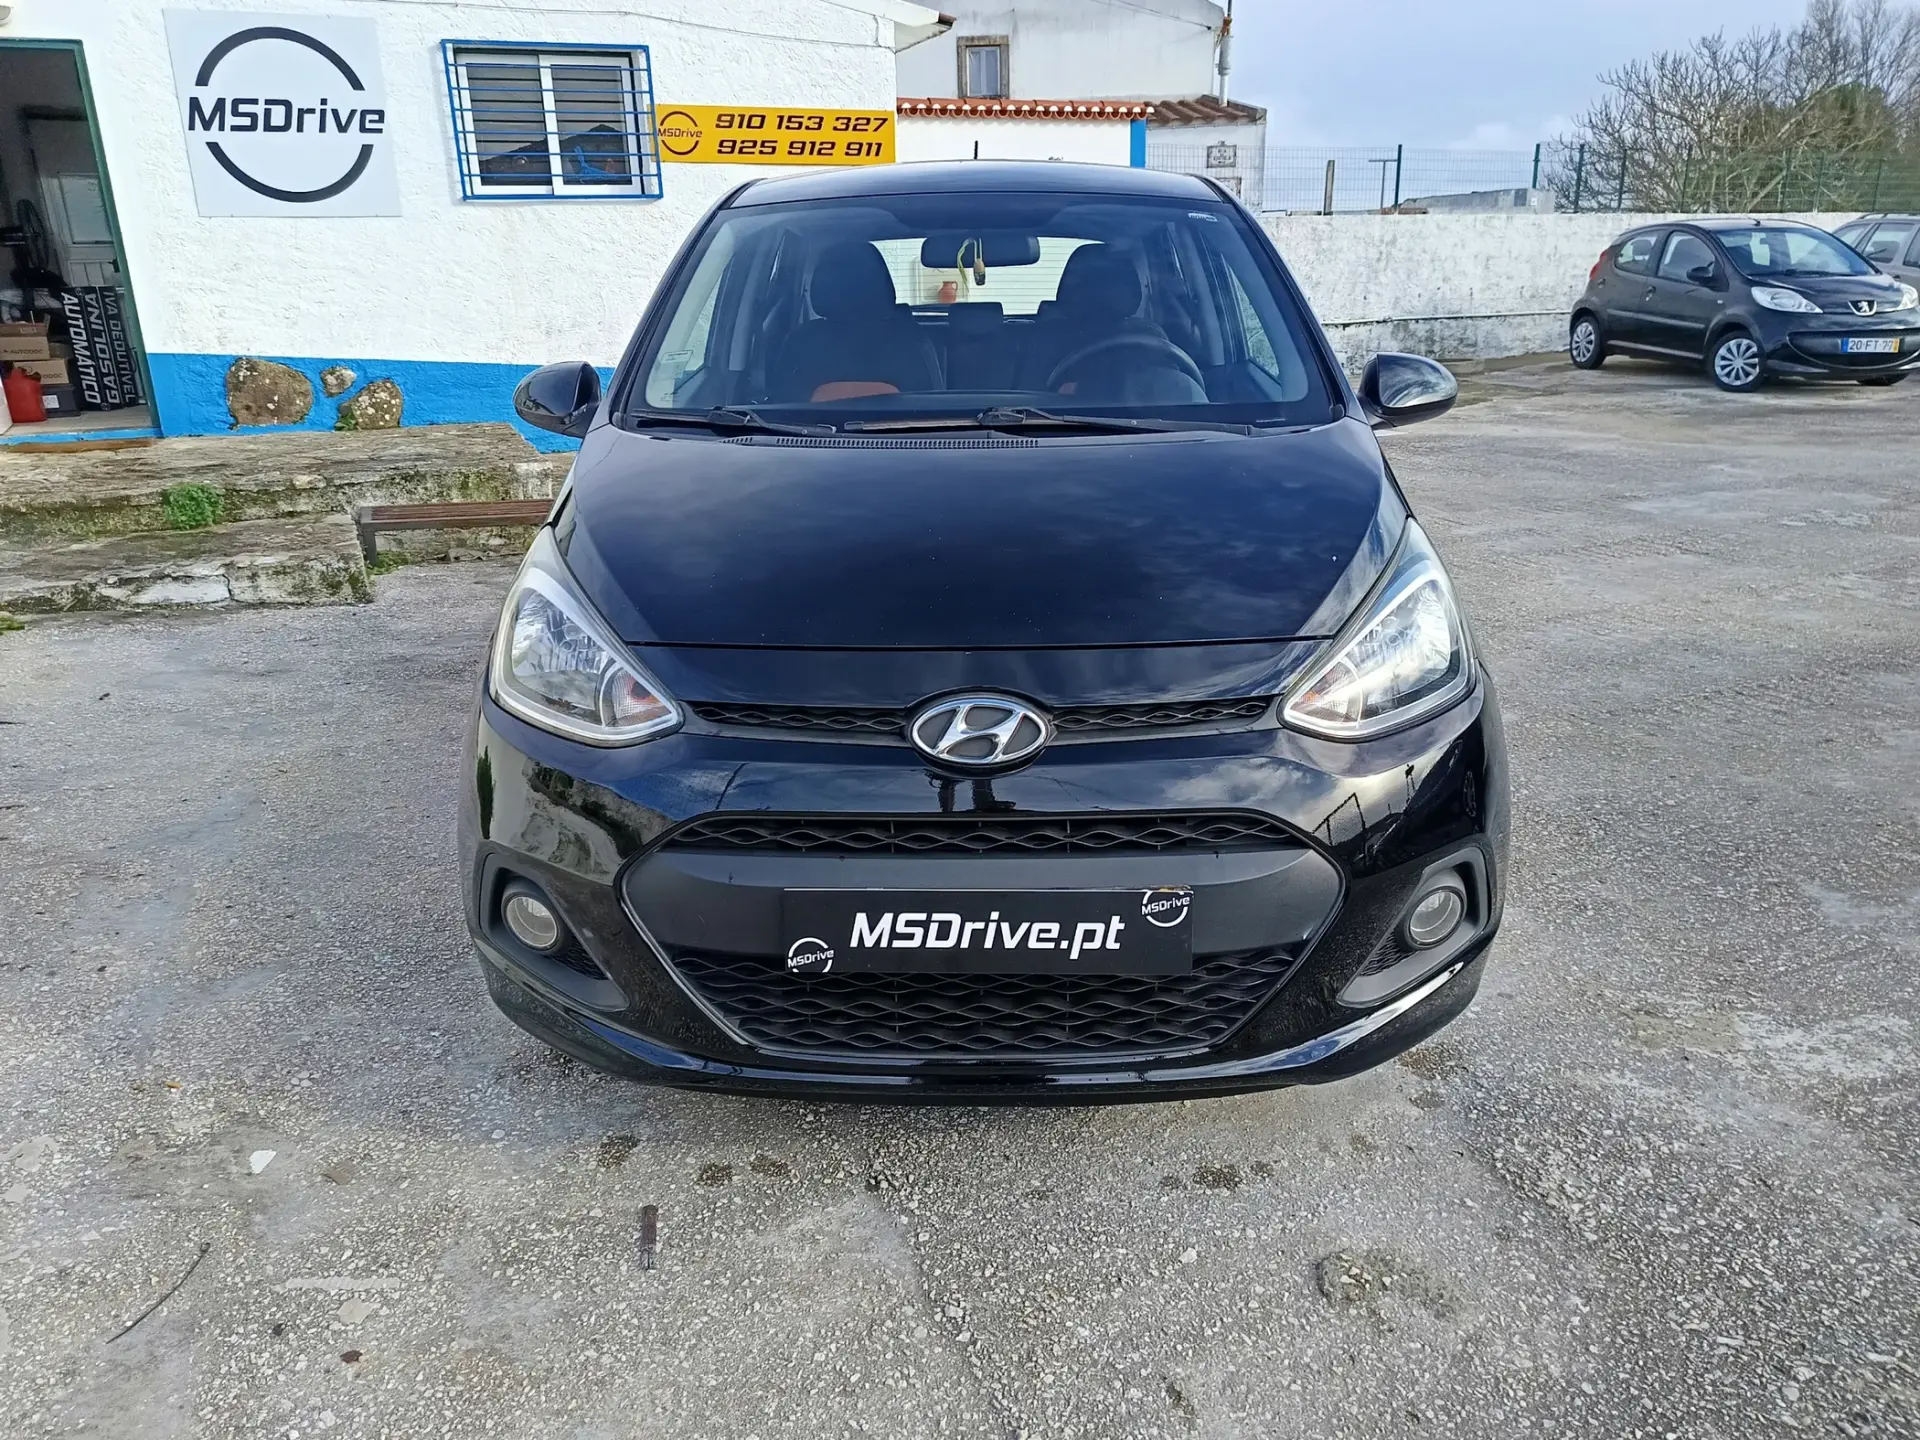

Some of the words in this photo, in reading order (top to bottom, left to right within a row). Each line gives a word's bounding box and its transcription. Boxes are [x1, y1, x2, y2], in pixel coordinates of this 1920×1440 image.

[188, 96, 385, 134] MSDrive
[715, 113, 766, 129] 910
[776, 115, 824, 131] 153
[832, 116, 888, 132] 327
[658, 127, 703, 138] MSDrive
[717, 139, 778, 155] 925
[787, 140, 836, 156] 912
[844, 142, 883, 157] 911
[103, 291, 119, 315] IVA
[85, 293, 120, 404] GASOLINA
[1849, 340, 1863, 351] 20
[1865, 340, 1879, 351] FT
[1882, 340, 1894, 351] 77
[1142, 895, 1190, 916] MSDrive
[850, 911, 1126, 960] MSDrive.pt
[787, 949, 835, 969] MSDrive
